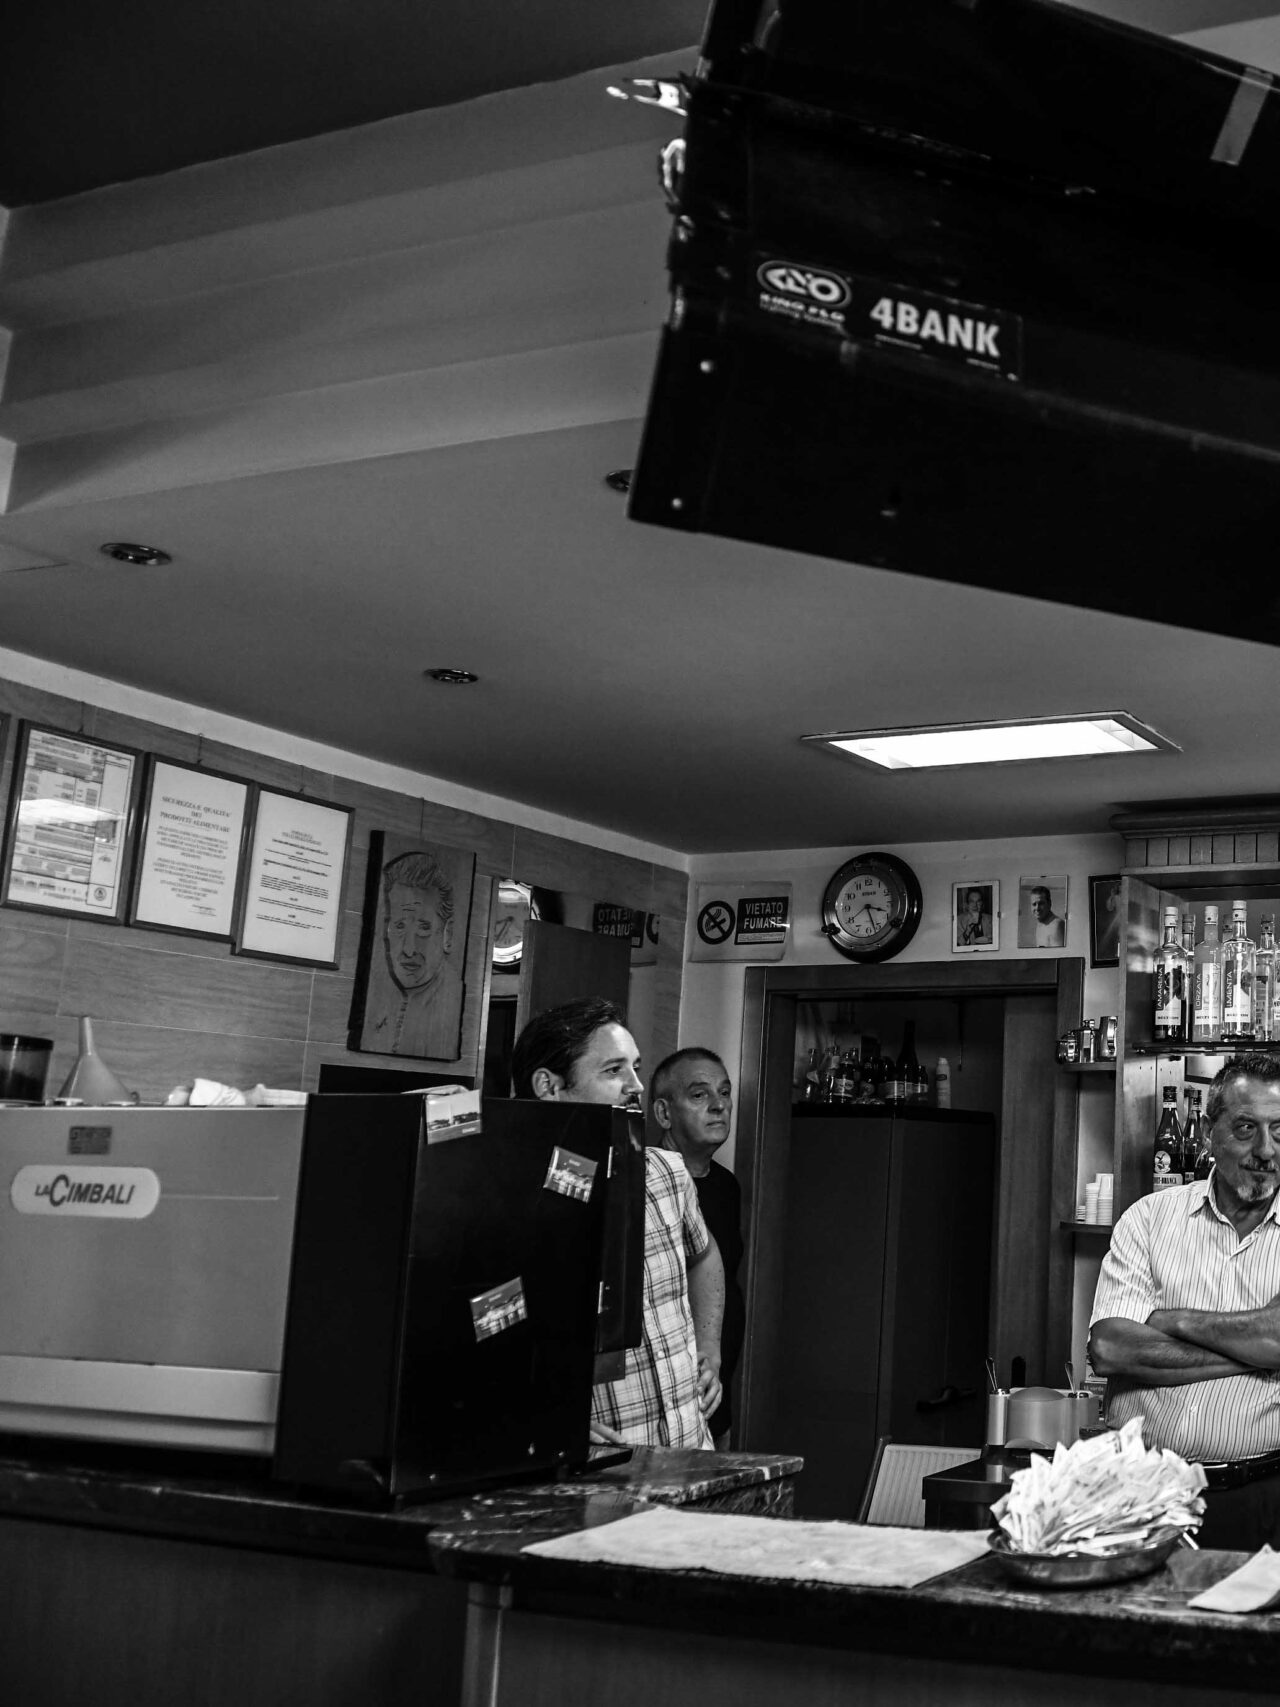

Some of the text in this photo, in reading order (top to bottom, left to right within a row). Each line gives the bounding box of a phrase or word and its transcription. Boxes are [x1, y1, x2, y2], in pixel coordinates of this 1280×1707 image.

[870, 297, 999, 357] 4BANK
[160, 811, 193, 825] PRODOTTI
[745, 902, 784, 914] VIETATO
[743, 916, 783, 930] FUMARE
[34, 1174, 135, 1207] LA CIMBALI
